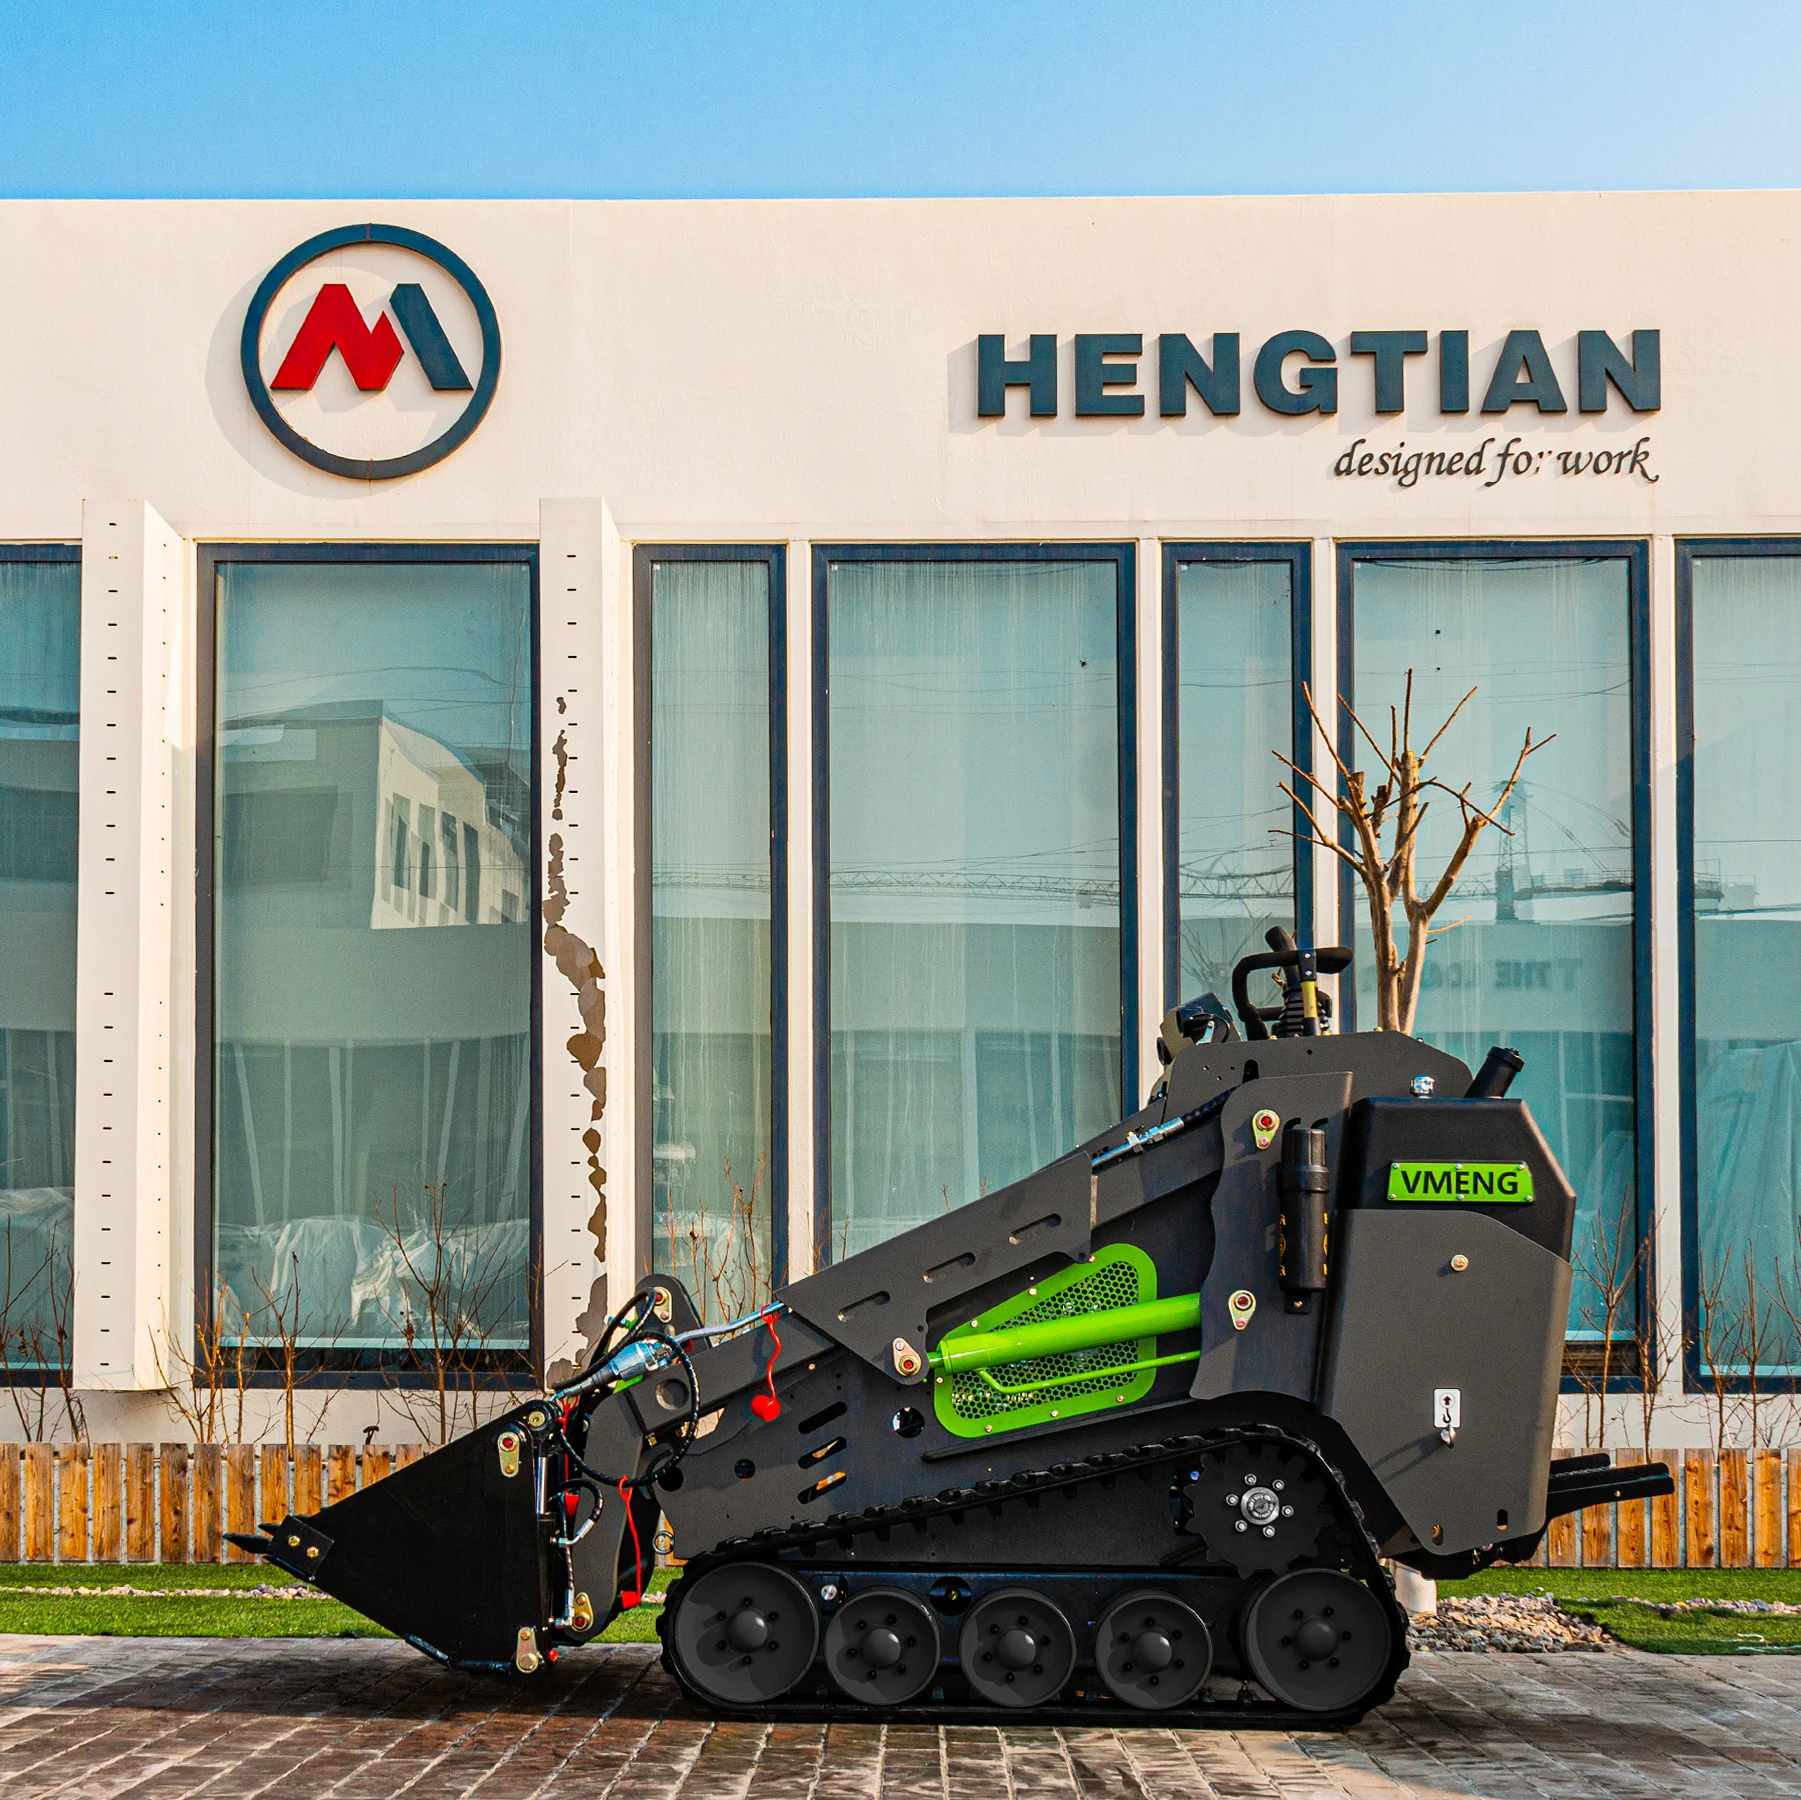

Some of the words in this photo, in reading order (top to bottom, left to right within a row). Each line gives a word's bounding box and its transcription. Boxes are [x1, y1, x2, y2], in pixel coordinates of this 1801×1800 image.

[977, 329, 1661, 417] HENGTIAN
[1334, 437, 1496, 487] designed
[1556, 436, 1660, 483] work
[1400, 1170, 1518, 1195] VMENG
